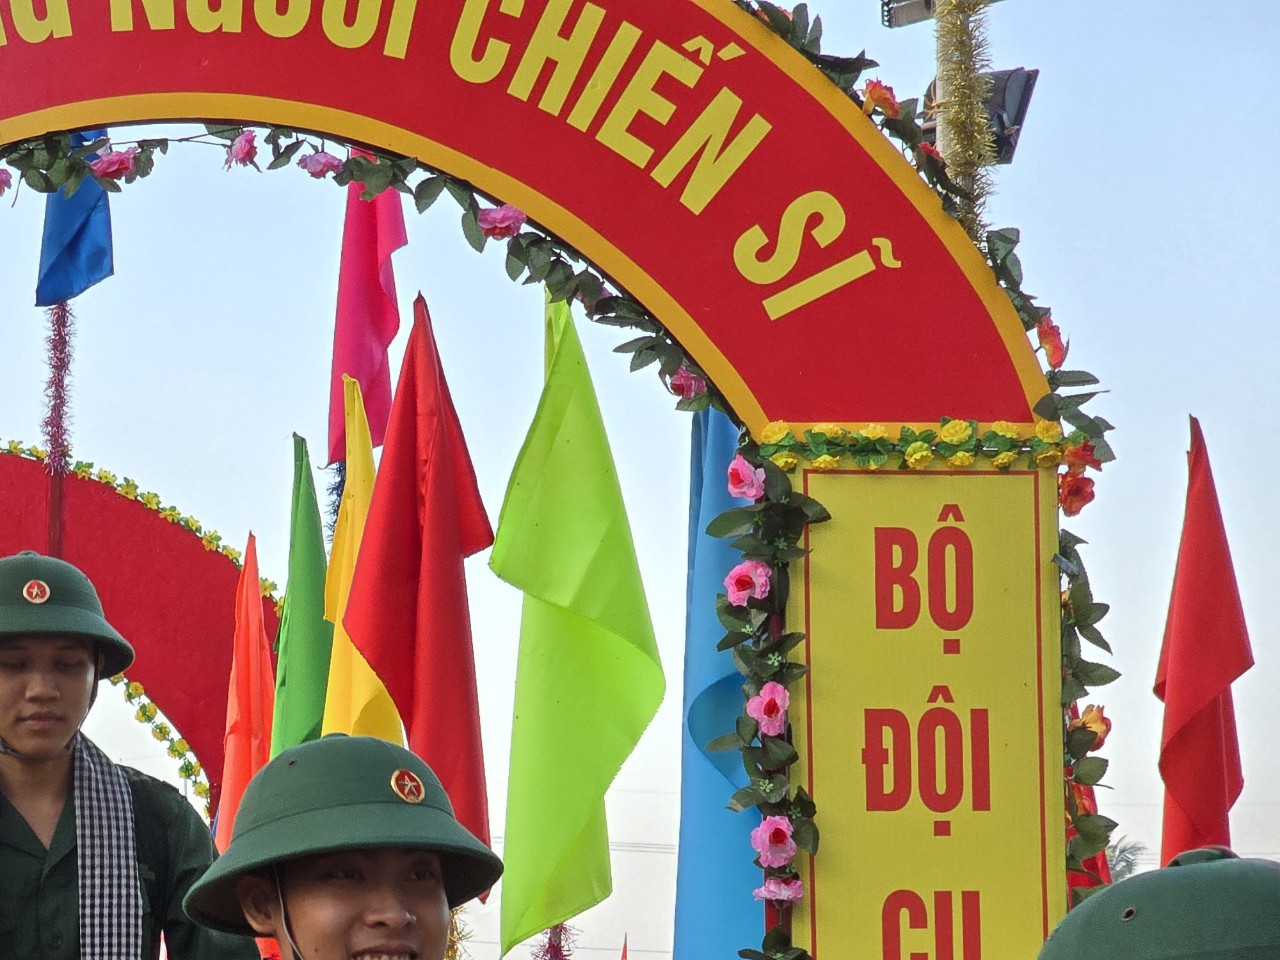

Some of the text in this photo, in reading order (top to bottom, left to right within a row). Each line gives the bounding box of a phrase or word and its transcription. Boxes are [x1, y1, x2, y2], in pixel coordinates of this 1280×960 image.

[450, 0, 773, 216] CHIẾN
[733, 190, 902, 321] SĨ
[874, 504, 974, 655] BỘ
[861, 685, 991, 837] ĐỘI
